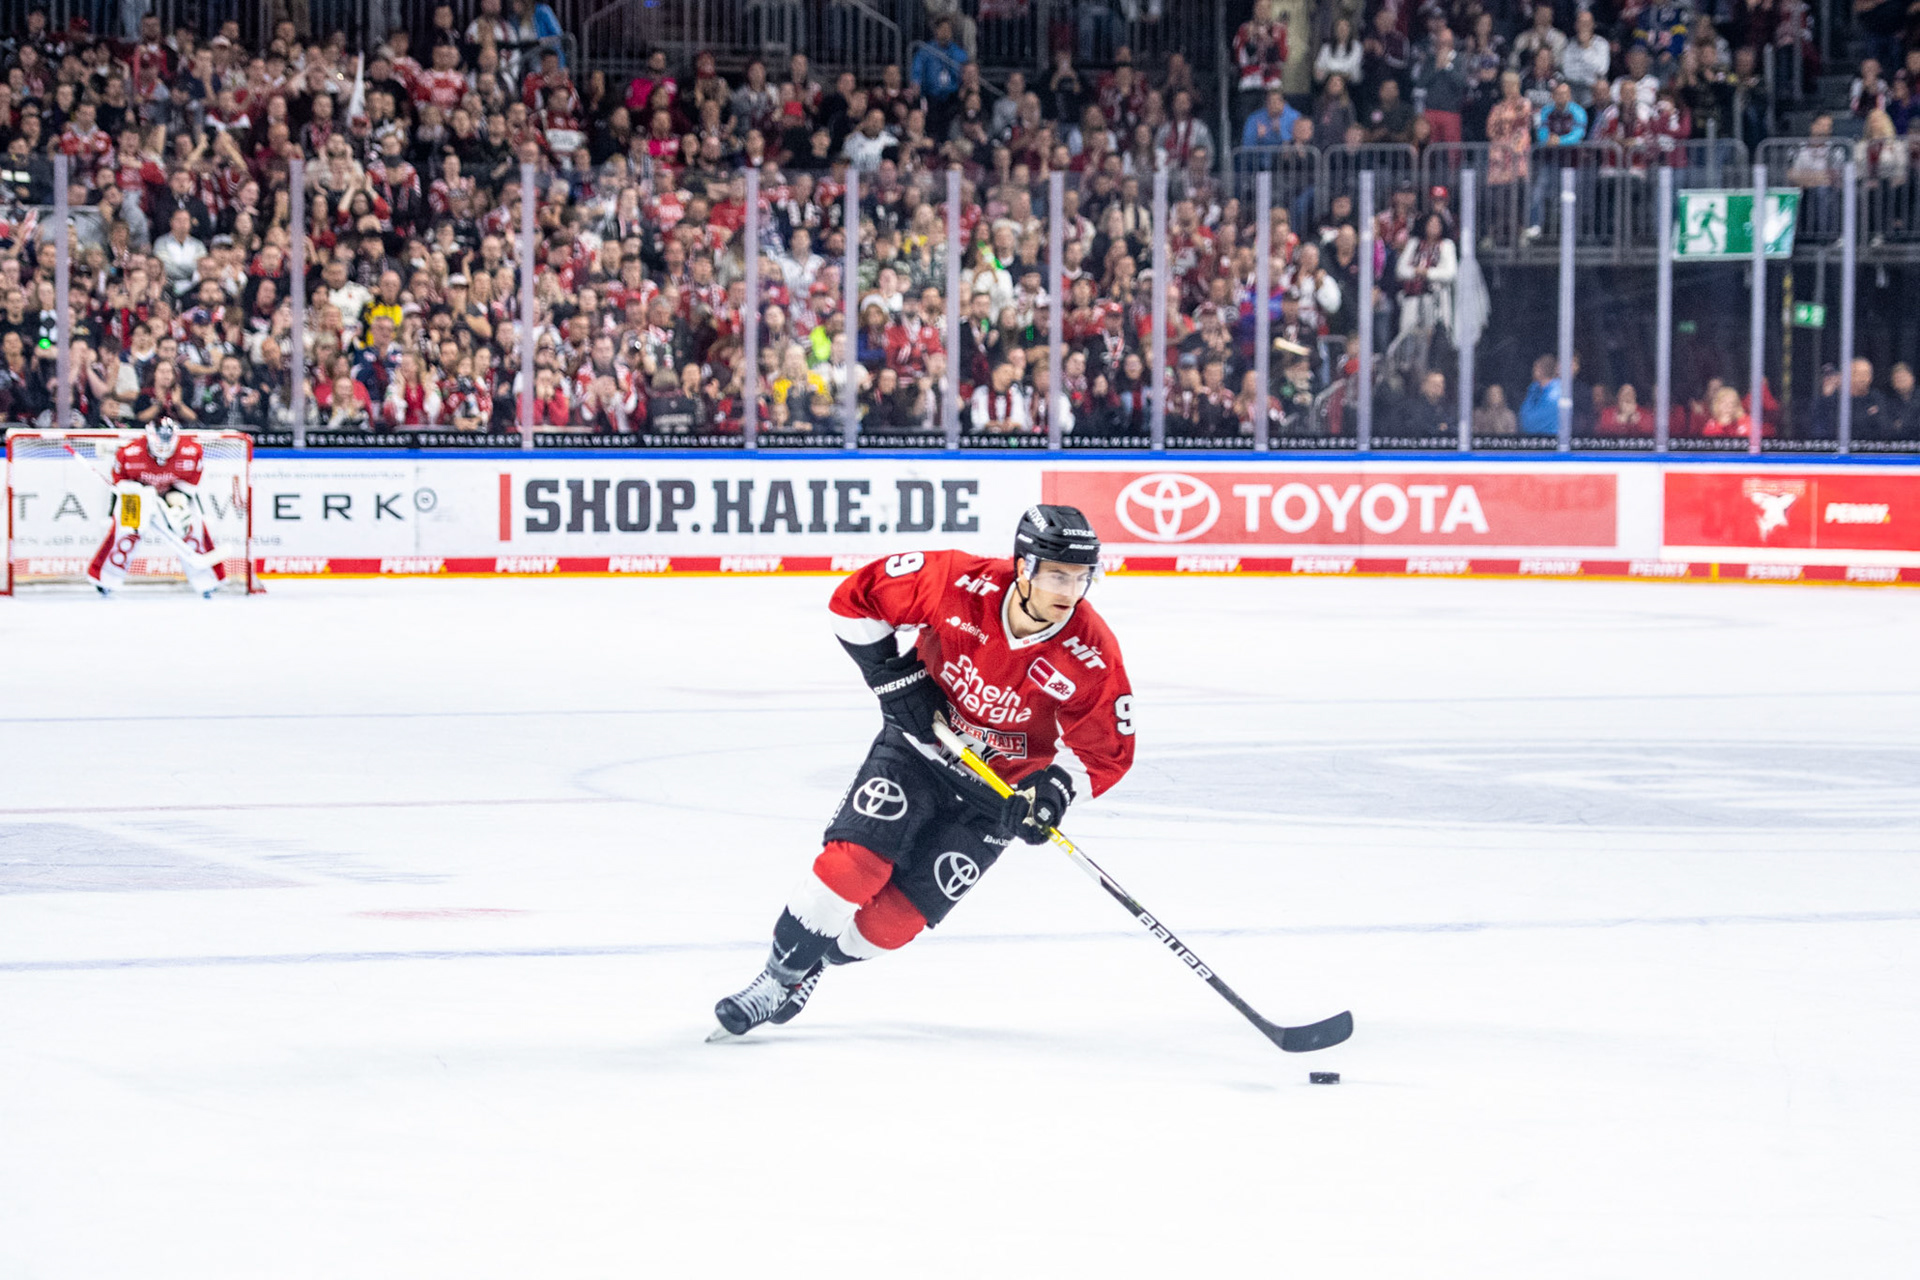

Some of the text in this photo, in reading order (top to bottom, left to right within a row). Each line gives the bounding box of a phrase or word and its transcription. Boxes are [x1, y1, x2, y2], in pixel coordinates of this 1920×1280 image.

[525, 479, 980, 534] SHOP.HAIE.DE
[1232, 483, 1489, 534] TOYOTA
[873, 667, 929, 695] SHERWO
